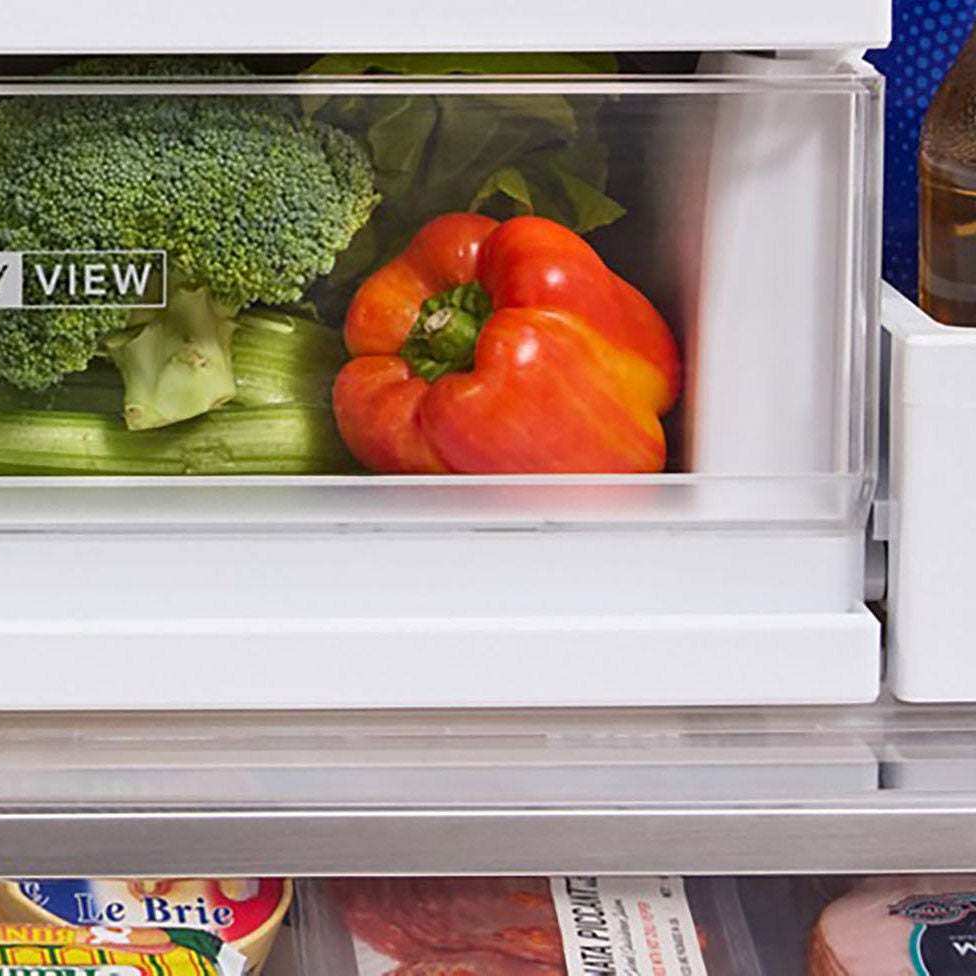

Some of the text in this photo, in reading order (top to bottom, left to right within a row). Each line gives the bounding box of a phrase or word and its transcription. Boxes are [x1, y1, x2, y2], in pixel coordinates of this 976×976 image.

[35, 263, 152, 296] VIEW
[74, 892, 125, 923] Le
[143, 895, 235, 926] Brie
